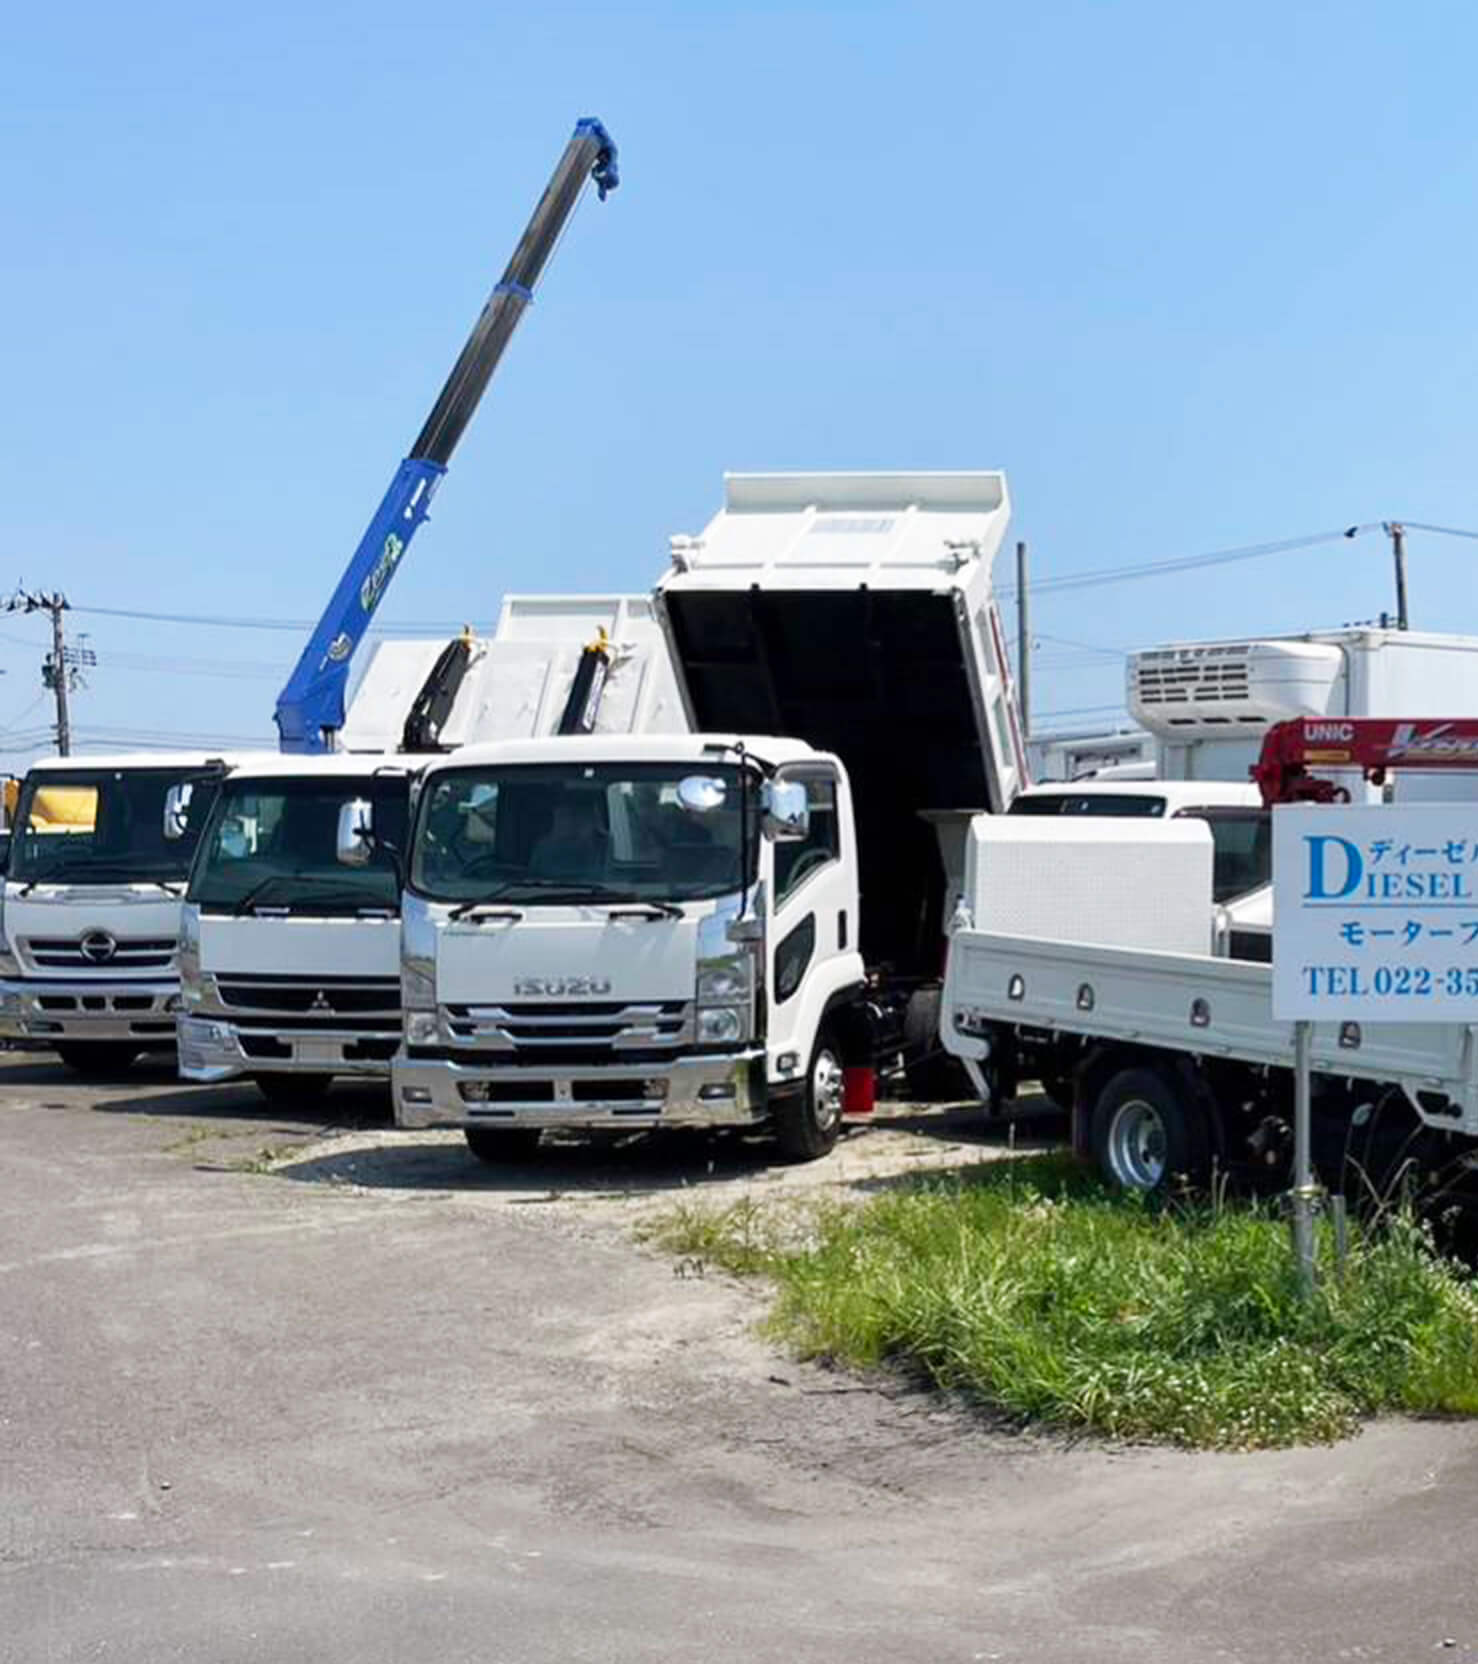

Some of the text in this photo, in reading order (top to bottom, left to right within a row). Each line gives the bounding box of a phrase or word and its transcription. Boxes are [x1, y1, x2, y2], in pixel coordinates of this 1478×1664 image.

[1303, 722, 1353, 741] UNIC
[1303, 835, 1472, 899] DIESEL
[513, 975, 612, 996] ISUZU
